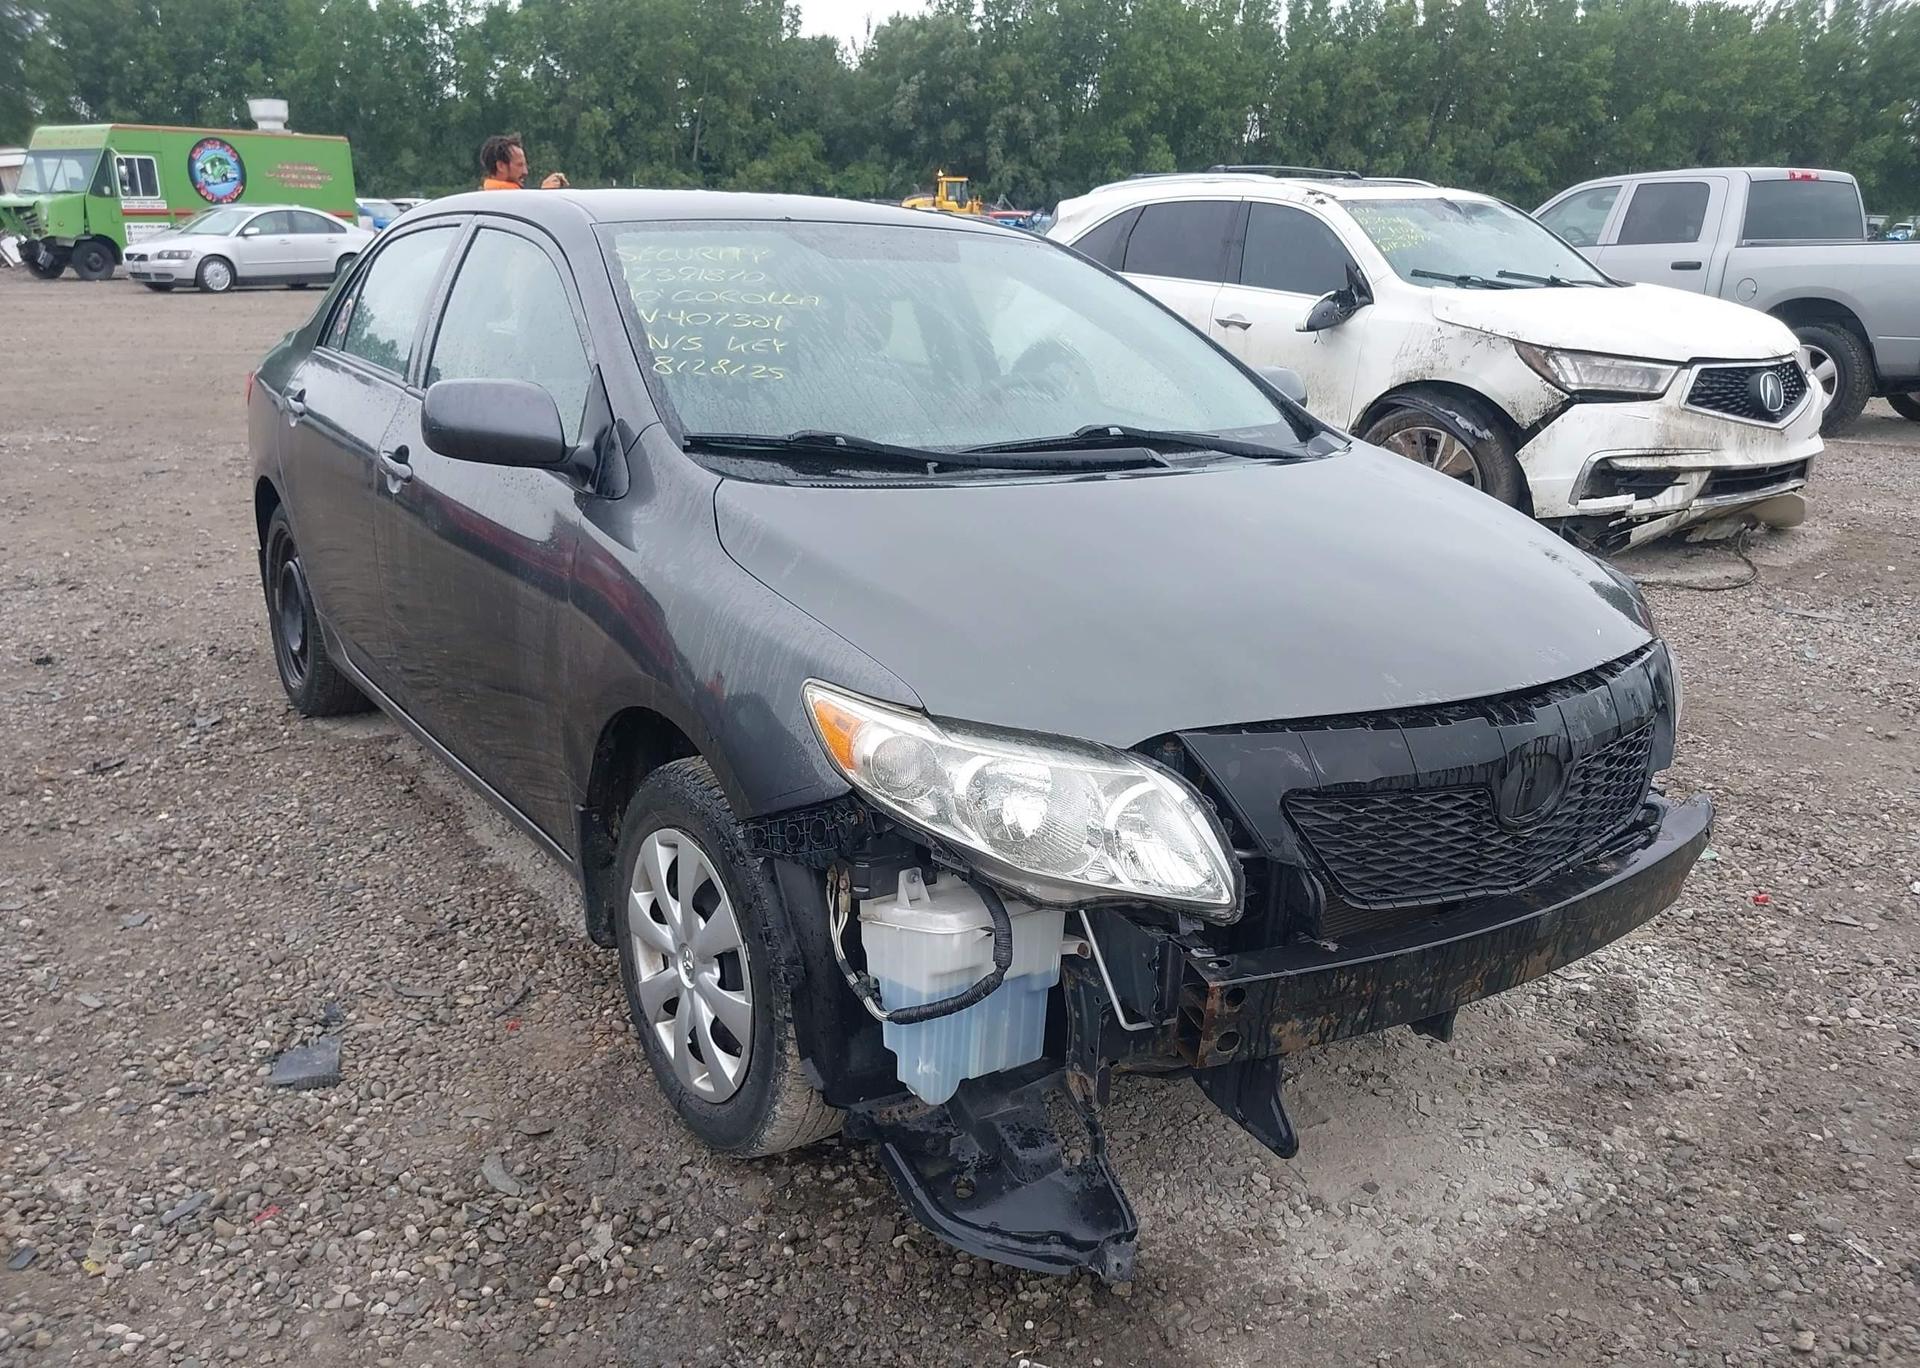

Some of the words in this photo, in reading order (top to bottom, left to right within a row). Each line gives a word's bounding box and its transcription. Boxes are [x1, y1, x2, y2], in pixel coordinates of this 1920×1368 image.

[615, 247, 769, 263] SECURITY
[671, 289, 820, 307] COROLLA
[648, 333, 702, 351] N/S
[727, 336, 788, 354] KEY
